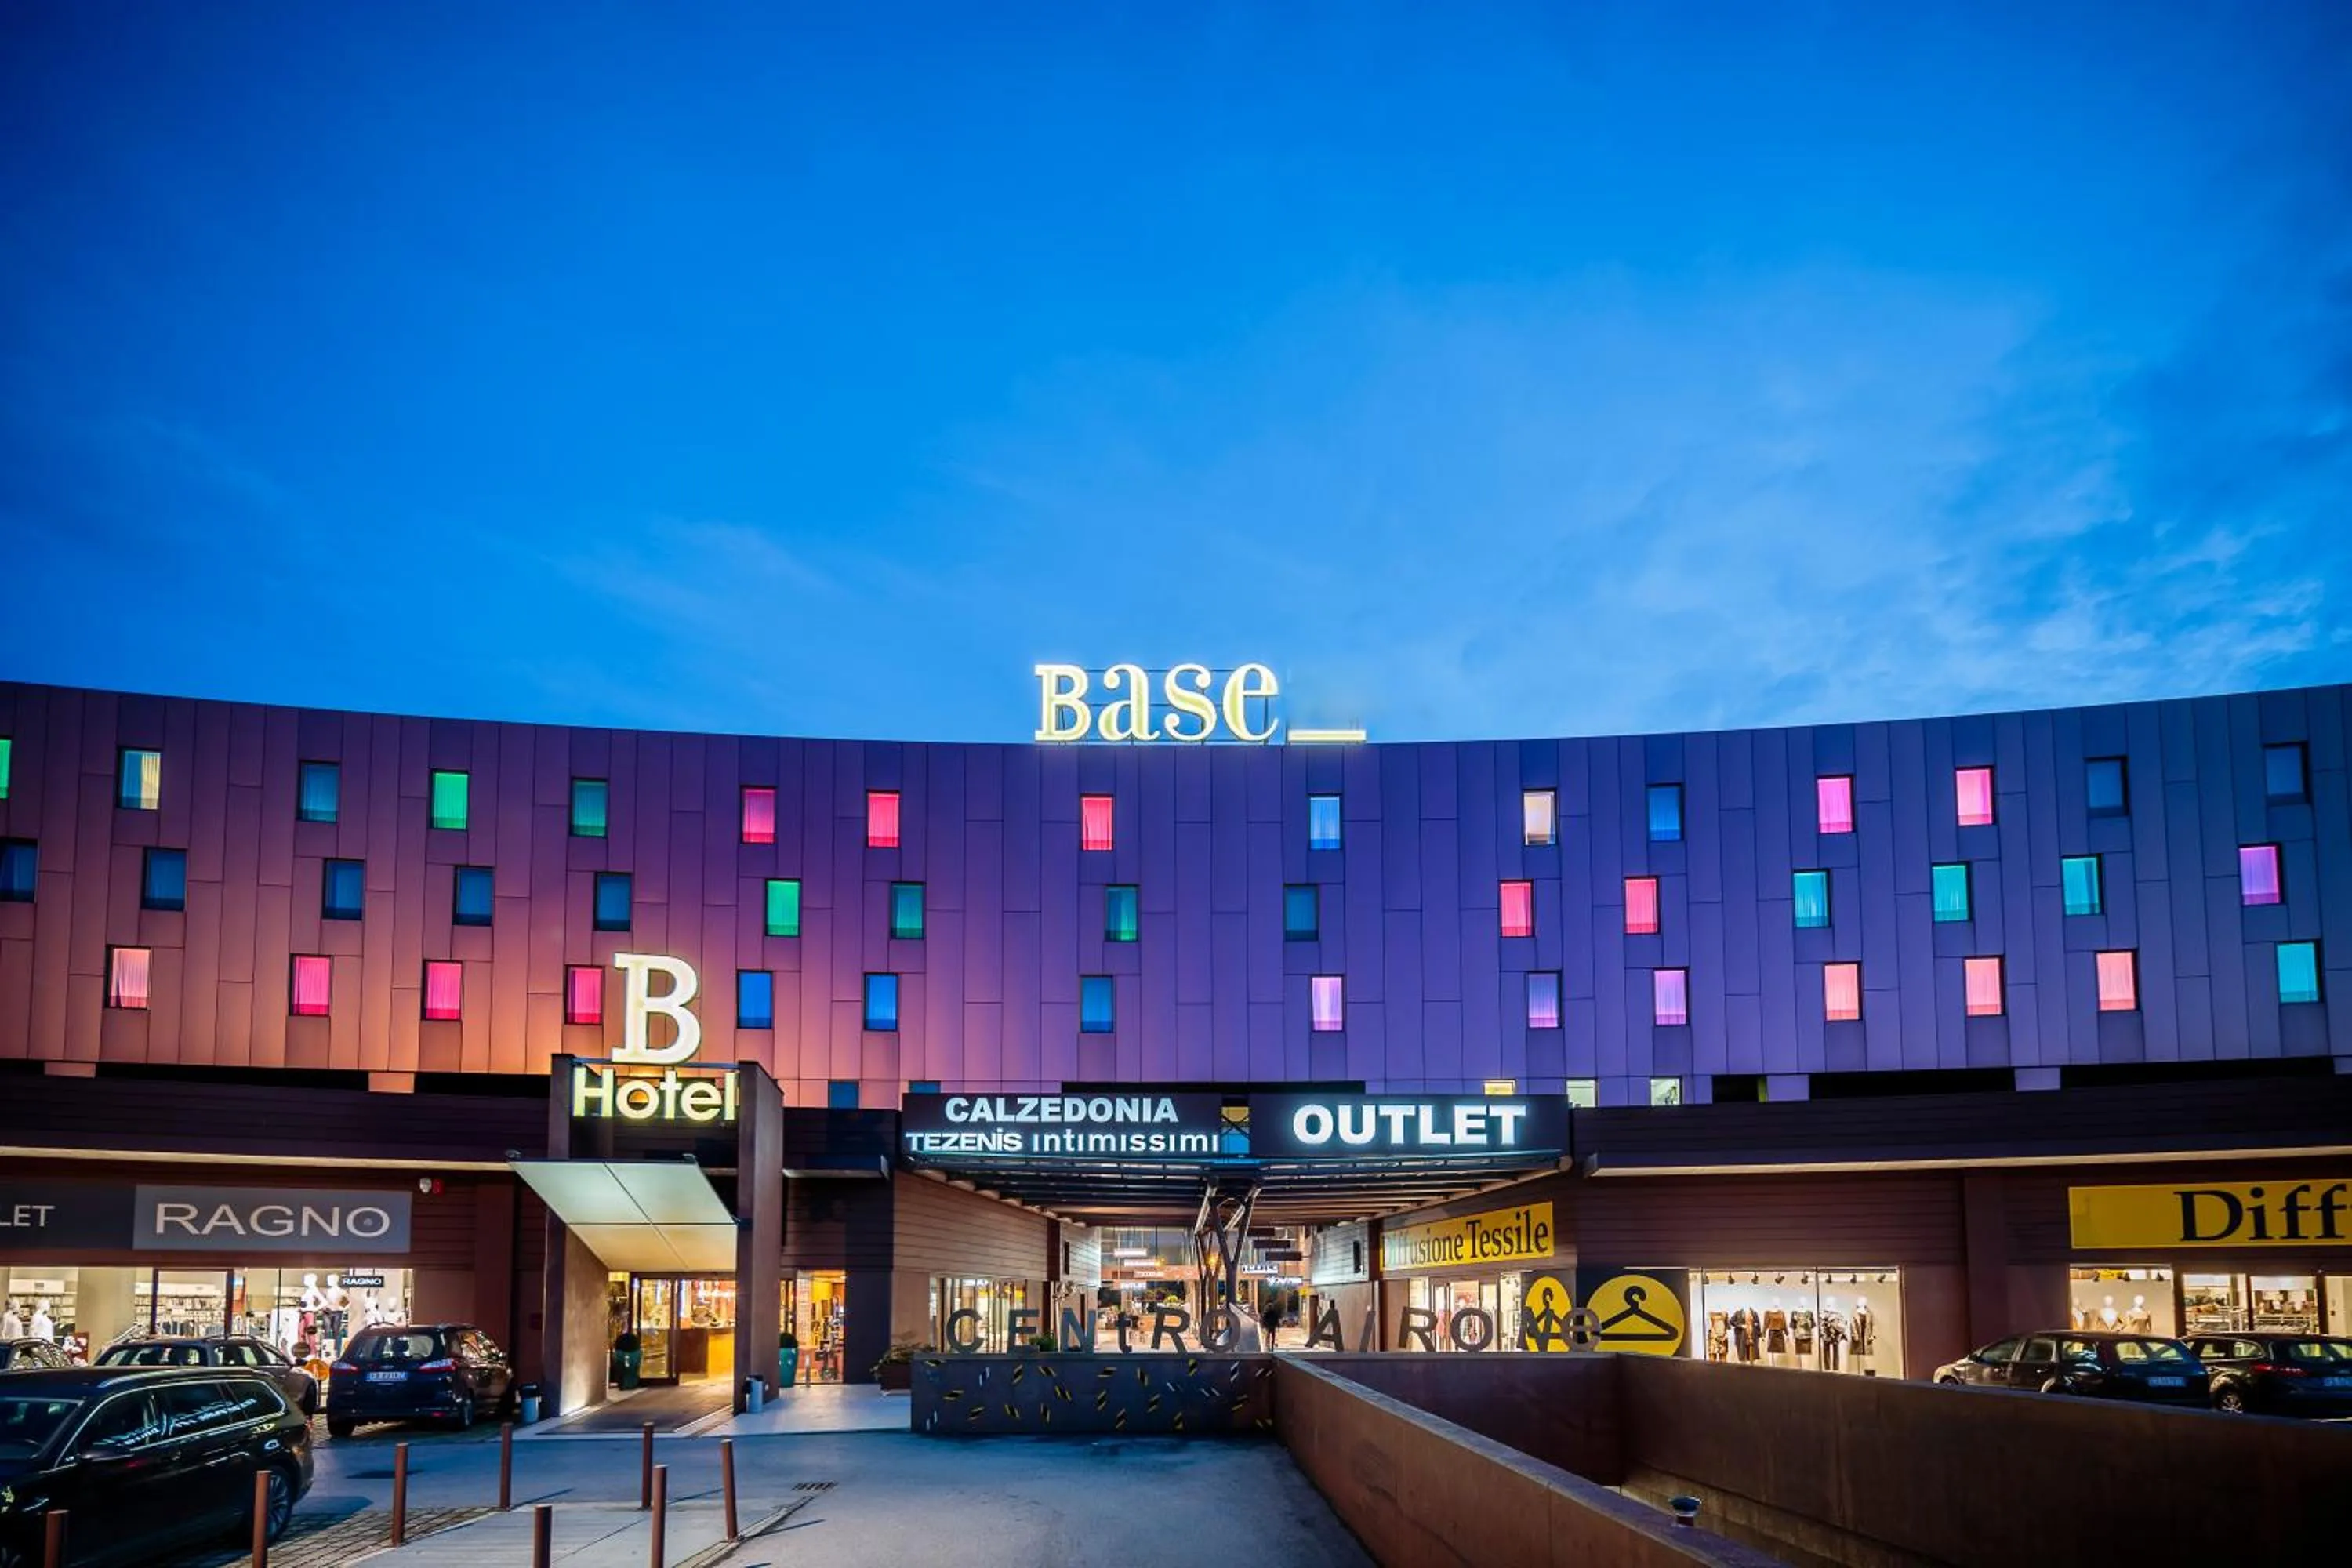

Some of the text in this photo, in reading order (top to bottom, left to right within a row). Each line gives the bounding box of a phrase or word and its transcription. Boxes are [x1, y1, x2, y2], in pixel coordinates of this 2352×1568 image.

[611, 953, 702, 1064] B
[573, 1067, 735, 1121] Hotel
[946, 1097, 1178, 1123] CALZEDONIA
[1293, 1104, 1526, 1144] OUTLET
[156, 1203, 390, 1236] RAGNO
[1466, 1210, 1549, 1259] Tessile
[2173, 1184, 2352, 1242] Diff
